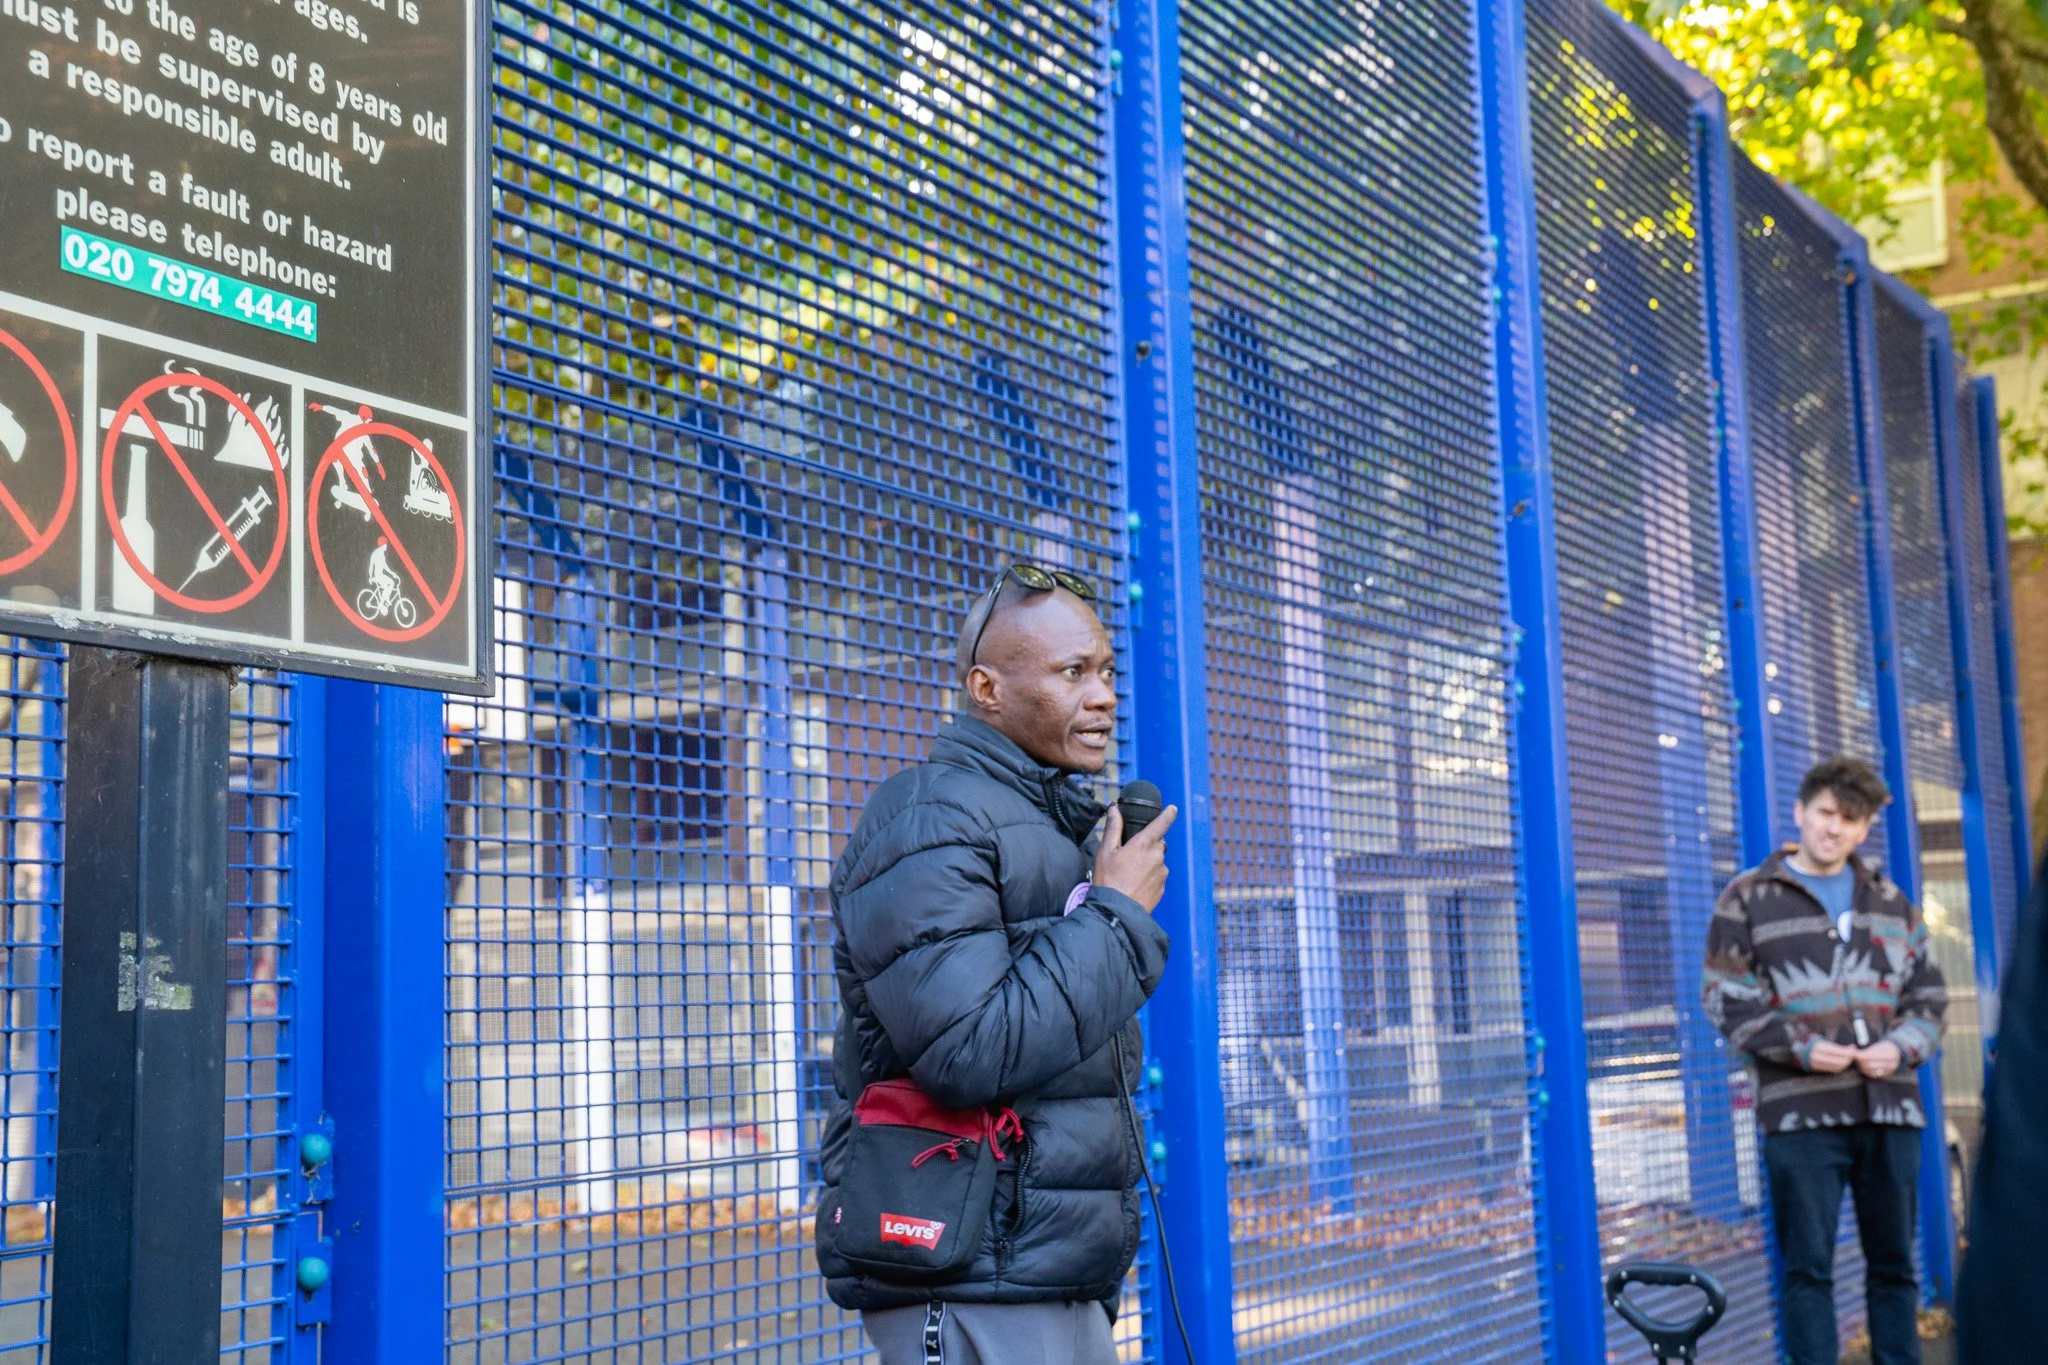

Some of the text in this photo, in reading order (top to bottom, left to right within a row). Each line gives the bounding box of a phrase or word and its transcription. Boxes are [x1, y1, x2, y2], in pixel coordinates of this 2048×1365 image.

[29, 50, 351, 190] a responsible adult.
[97, 18, 141, 64] be
[158, 52, 338, 143] supervised
[353, 121, 385, 164] by
[147, 0, 195, 40] the
[209, 28, 259, 66] age
[272, 53, 297, 83] of
[309, 63, 325, 94] 8
[336, 81, 401, 127] years
[413, 111, 447, 145] old
[29, 128, 134, 185] report
[149, 171, 166, 195] a
[181, 173, 249, 224] fault
[263, 210, 291, 236] or
[304, 215, 391, 272] hazard
[57, 186, 336, 298] please telephone:
[65, 234, 314, 335] 020 7974 4444
